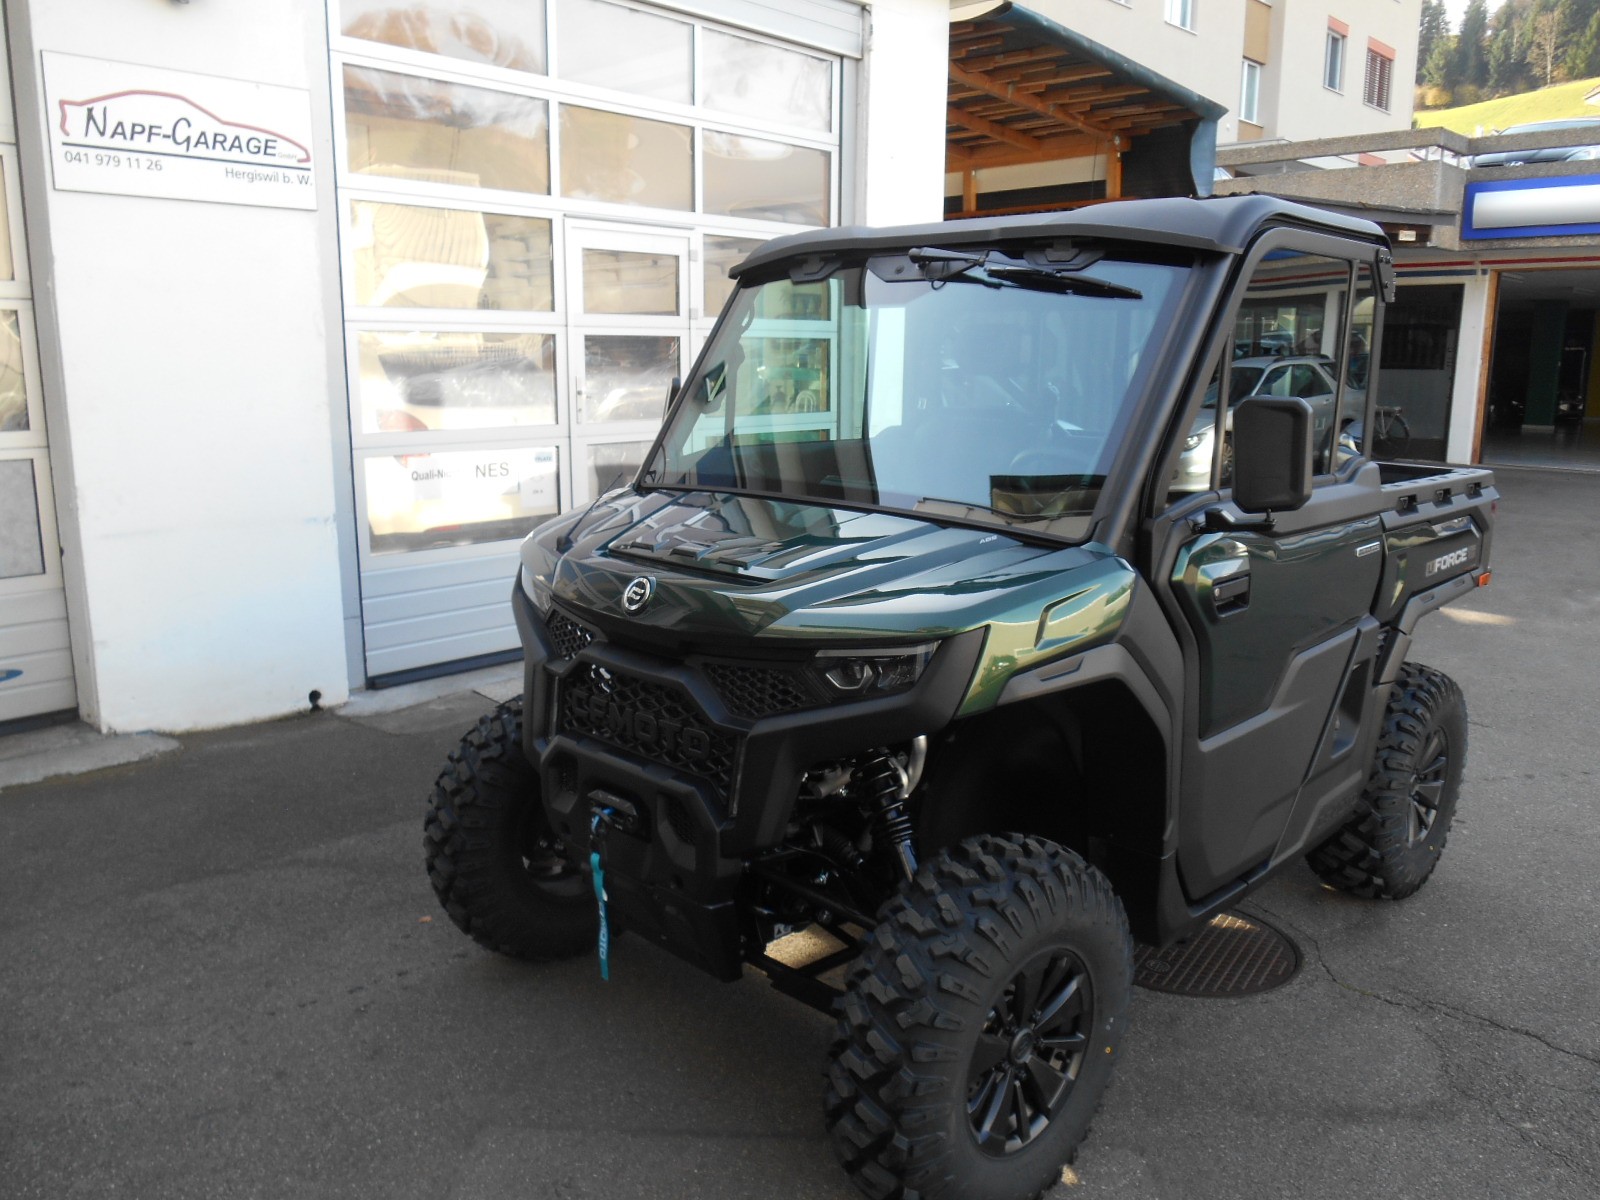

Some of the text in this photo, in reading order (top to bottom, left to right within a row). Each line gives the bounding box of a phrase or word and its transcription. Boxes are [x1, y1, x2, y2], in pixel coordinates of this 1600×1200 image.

[64, 150, 163, 172] 041 979 11 26
[225, 167, 314, 187] Hergiswil b. W.
[475, 462, 510, 479] NES
